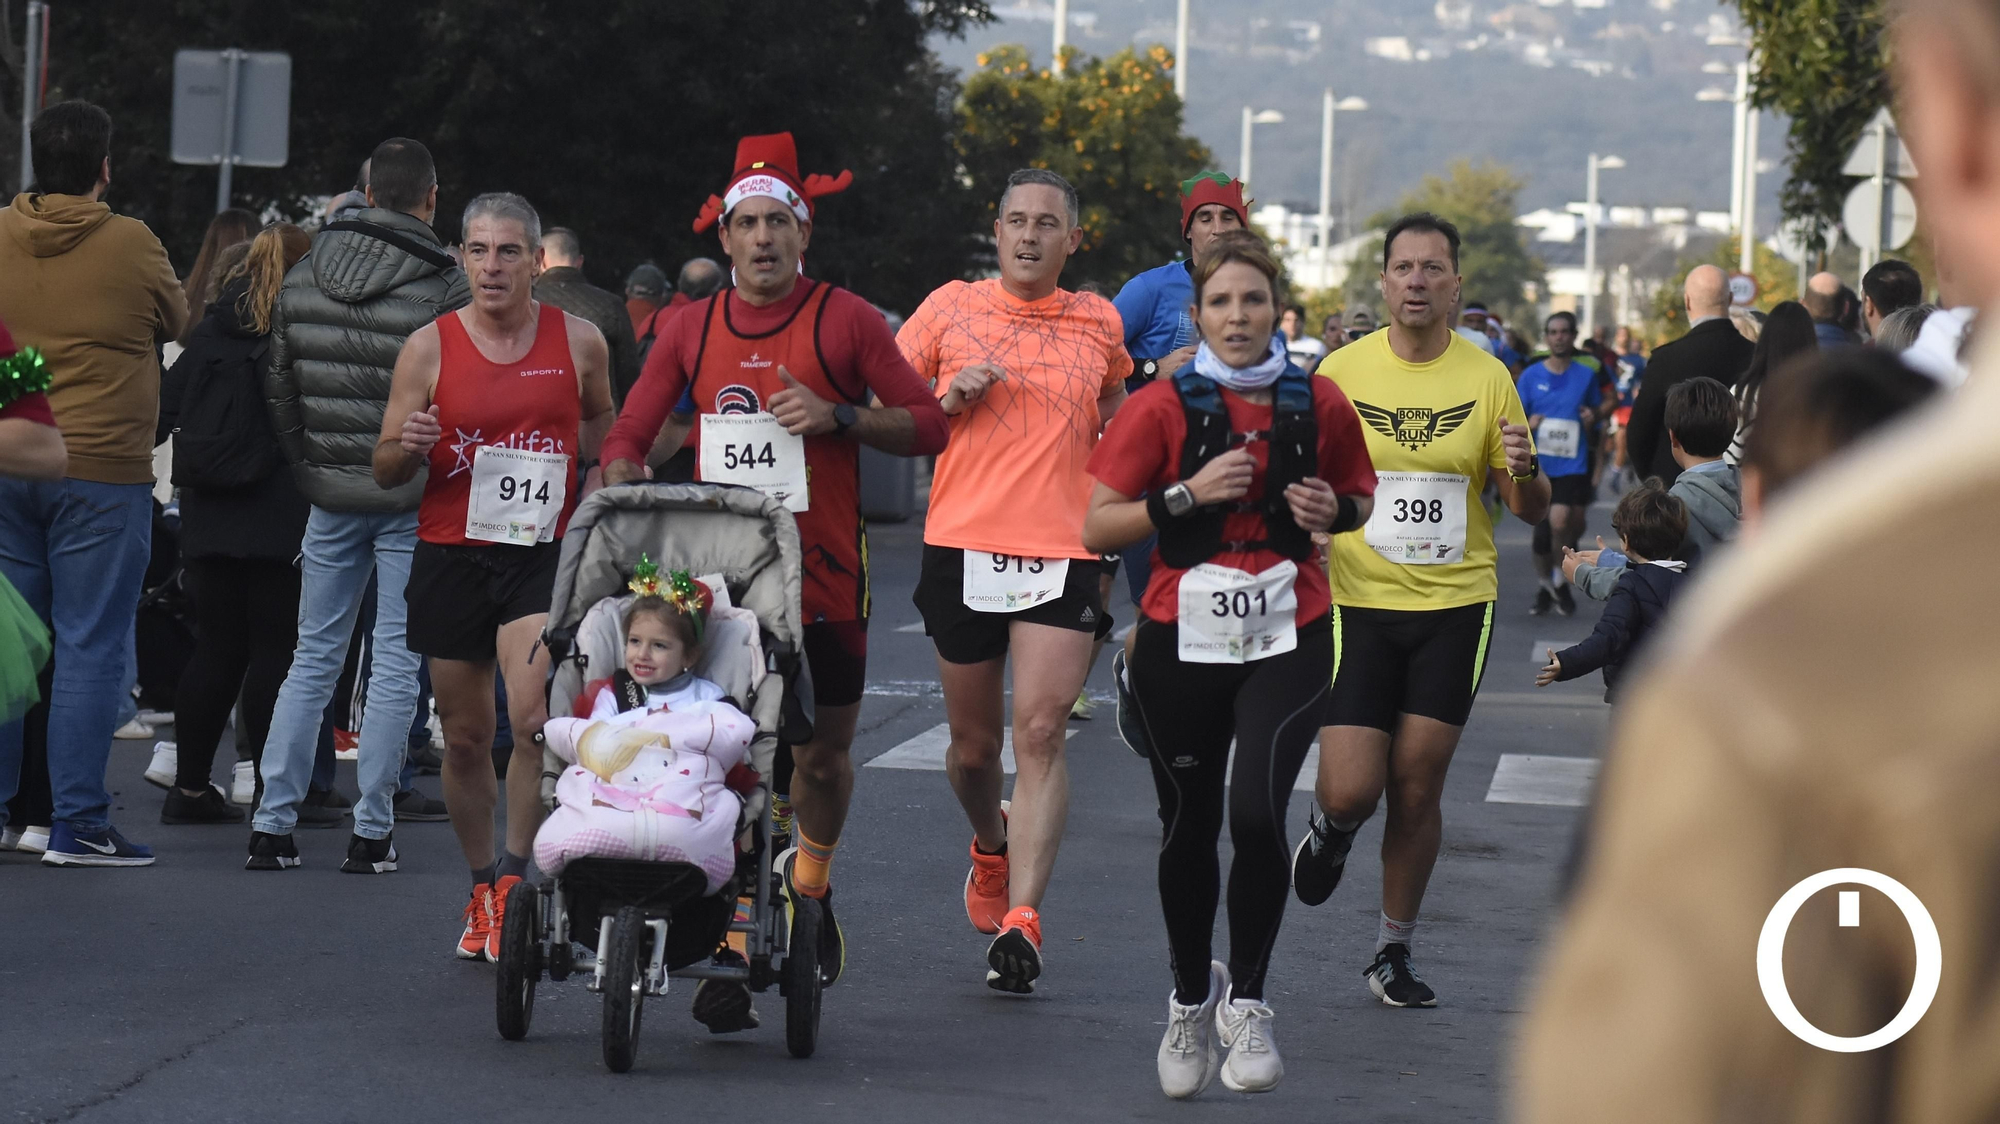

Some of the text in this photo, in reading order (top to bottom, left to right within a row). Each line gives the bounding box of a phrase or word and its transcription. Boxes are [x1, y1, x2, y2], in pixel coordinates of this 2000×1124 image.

[520, 369, 556, 377] GSPORT
[1399, 410, 1430, 420] BORN
[1398, 430, 1430, 440] RUN
[505, 452, 538, 462] SILVESTRE
[724, 442, 776, 470] 544
[499, 475, 550, 506] 914
[1393, 498, 1443, 524] 398
[478, 522, 507, 532] IMDECO
[992, 553, 1045, 575] 913
[1211, 589, 1267, 619] 301
[1192, 642, 1226, 650] IMDECO
